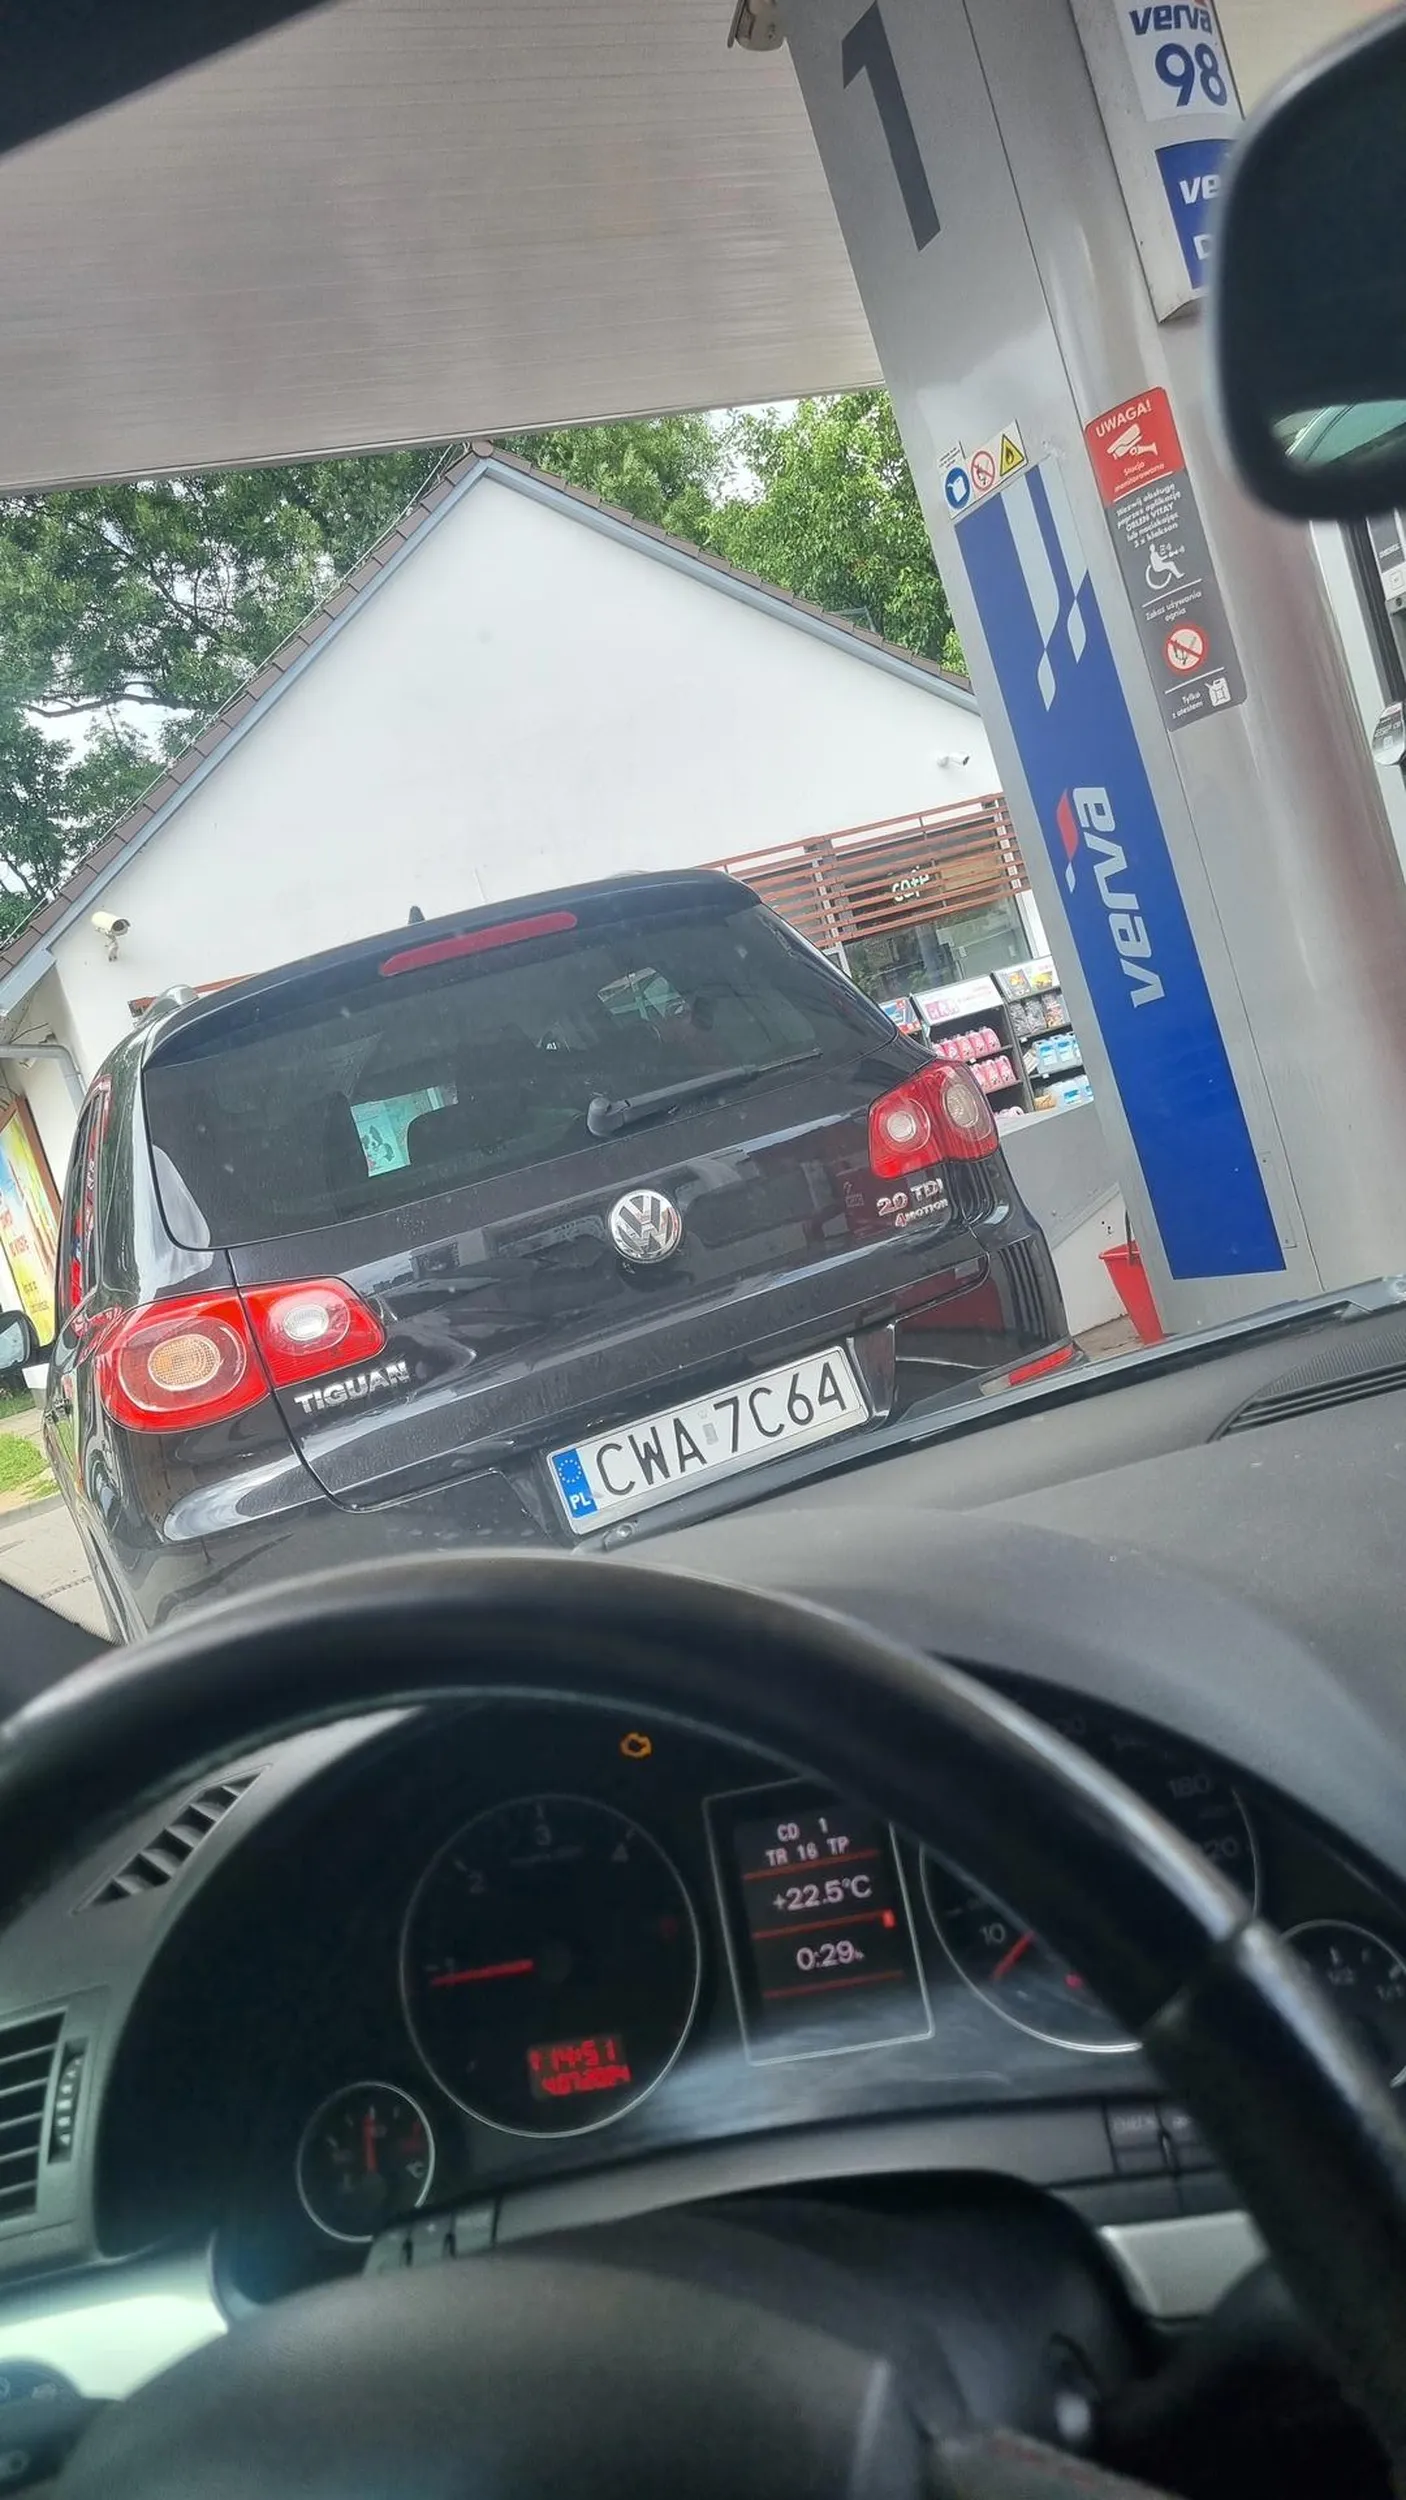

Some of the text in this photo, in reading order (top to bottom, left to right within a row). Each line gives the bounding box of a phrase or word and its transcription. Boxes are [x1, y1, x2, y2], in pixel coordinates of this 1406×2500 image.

[1129, 4, 1213, 36] verva
[1155, 43, 1228, 107] 98
[841, 3, 941, 252] 1
[1095, 399, 1153, 438] UWAGA!
[1123, 461, 1146, 476] Stacja
[1125, 502, 1175, 532] ORLEN VITAY
[1146, 522, 1179, 542] klakson
[1145, 590, 1203, 622] Zakaz używania
[1164, 608, 1187, 623] ognia
[1182, 691, 1201, 706] Tylko
[1072, 786, 1166, 1009] verva
[910, 1178, 944, 1202] TDI
[293, 1360, 411, 1414] TIGUAN
[595, 1361, 847, 1496] CWA 7C64
[569, 1491, 592, 1511] PL
[777, 1817, 829, 1842] CD 1
[765, 1847, 789, 1867] TR
[826, 1836, 850, 1855] TP
[772, 1874, 873, 1912] +22.5°C
